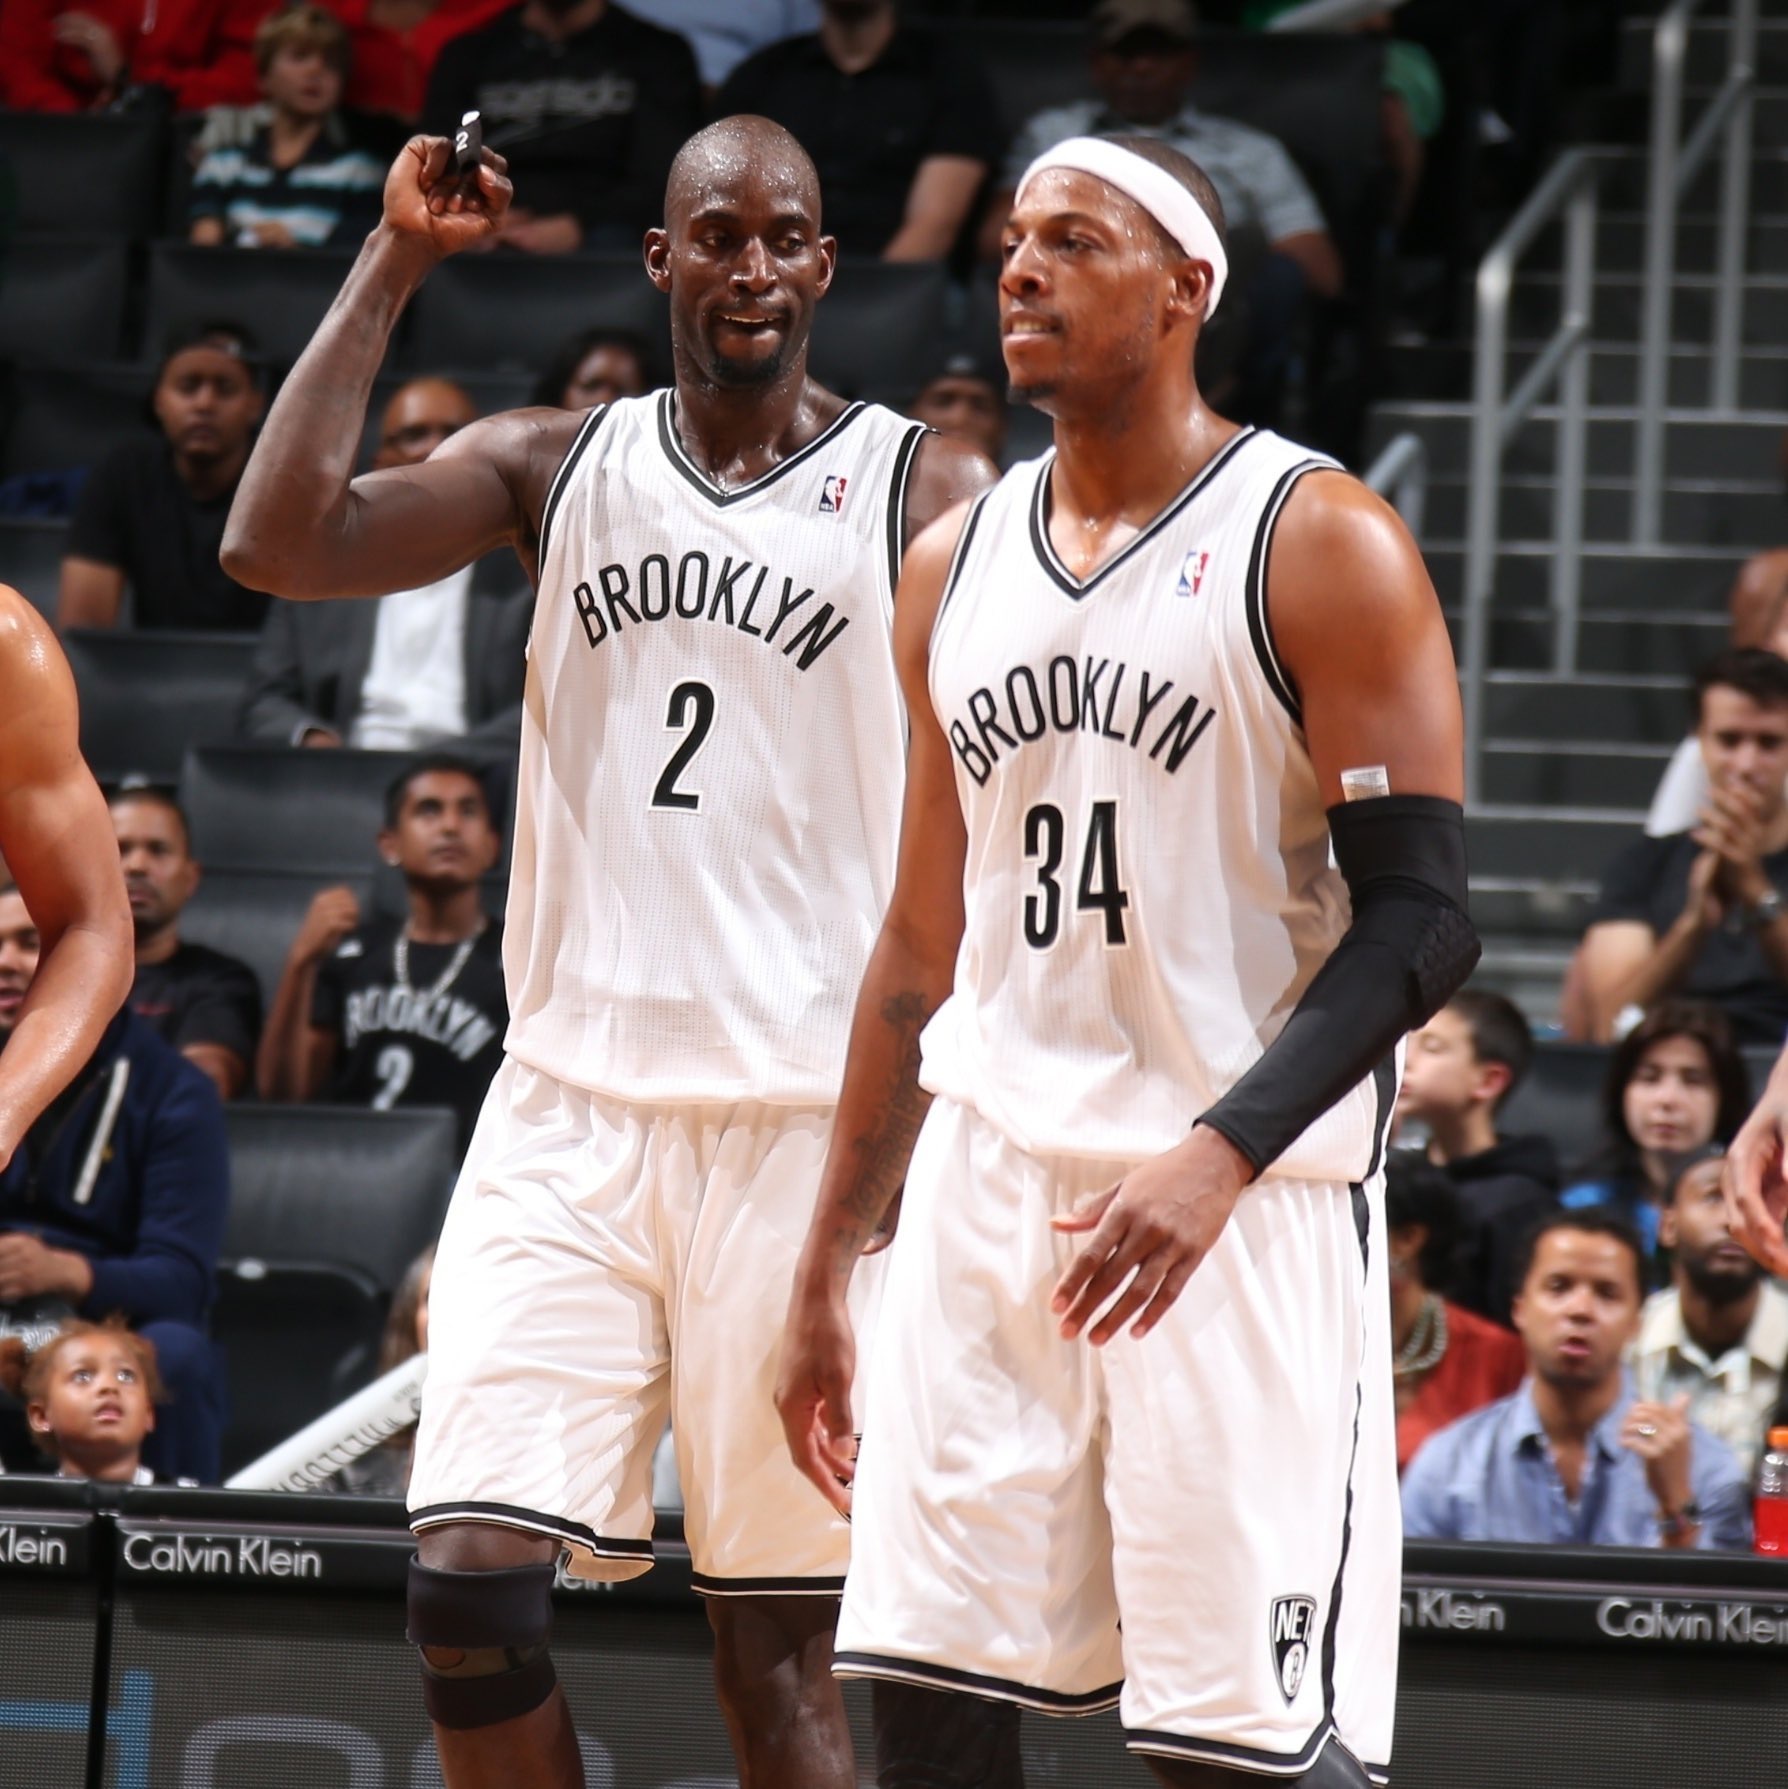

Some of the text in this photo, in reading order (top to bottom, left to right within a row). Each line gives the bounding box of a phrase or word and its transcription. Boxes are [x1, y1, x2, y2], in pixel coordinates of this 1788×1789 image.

[455, 130, 469, 154] 2
[573, 550, 850, 671] BROOKLYN
[650, 678, 717, 811] 2
[949, 655, 1216, 788] BROOKLYN
[1022, 799, 1130, 950] 34
[345, 983, 497, 1062] ROOKLYN
[371, 1044, 414, 1111] 2
[124, 1531, 322, 1578] Calvin Klein
[1275, 1600, 1314, 1643] NET
[1418, 1588, 1504, 1630] Klein
[1597, 1596, 1788, 1645] Calvin Klei
